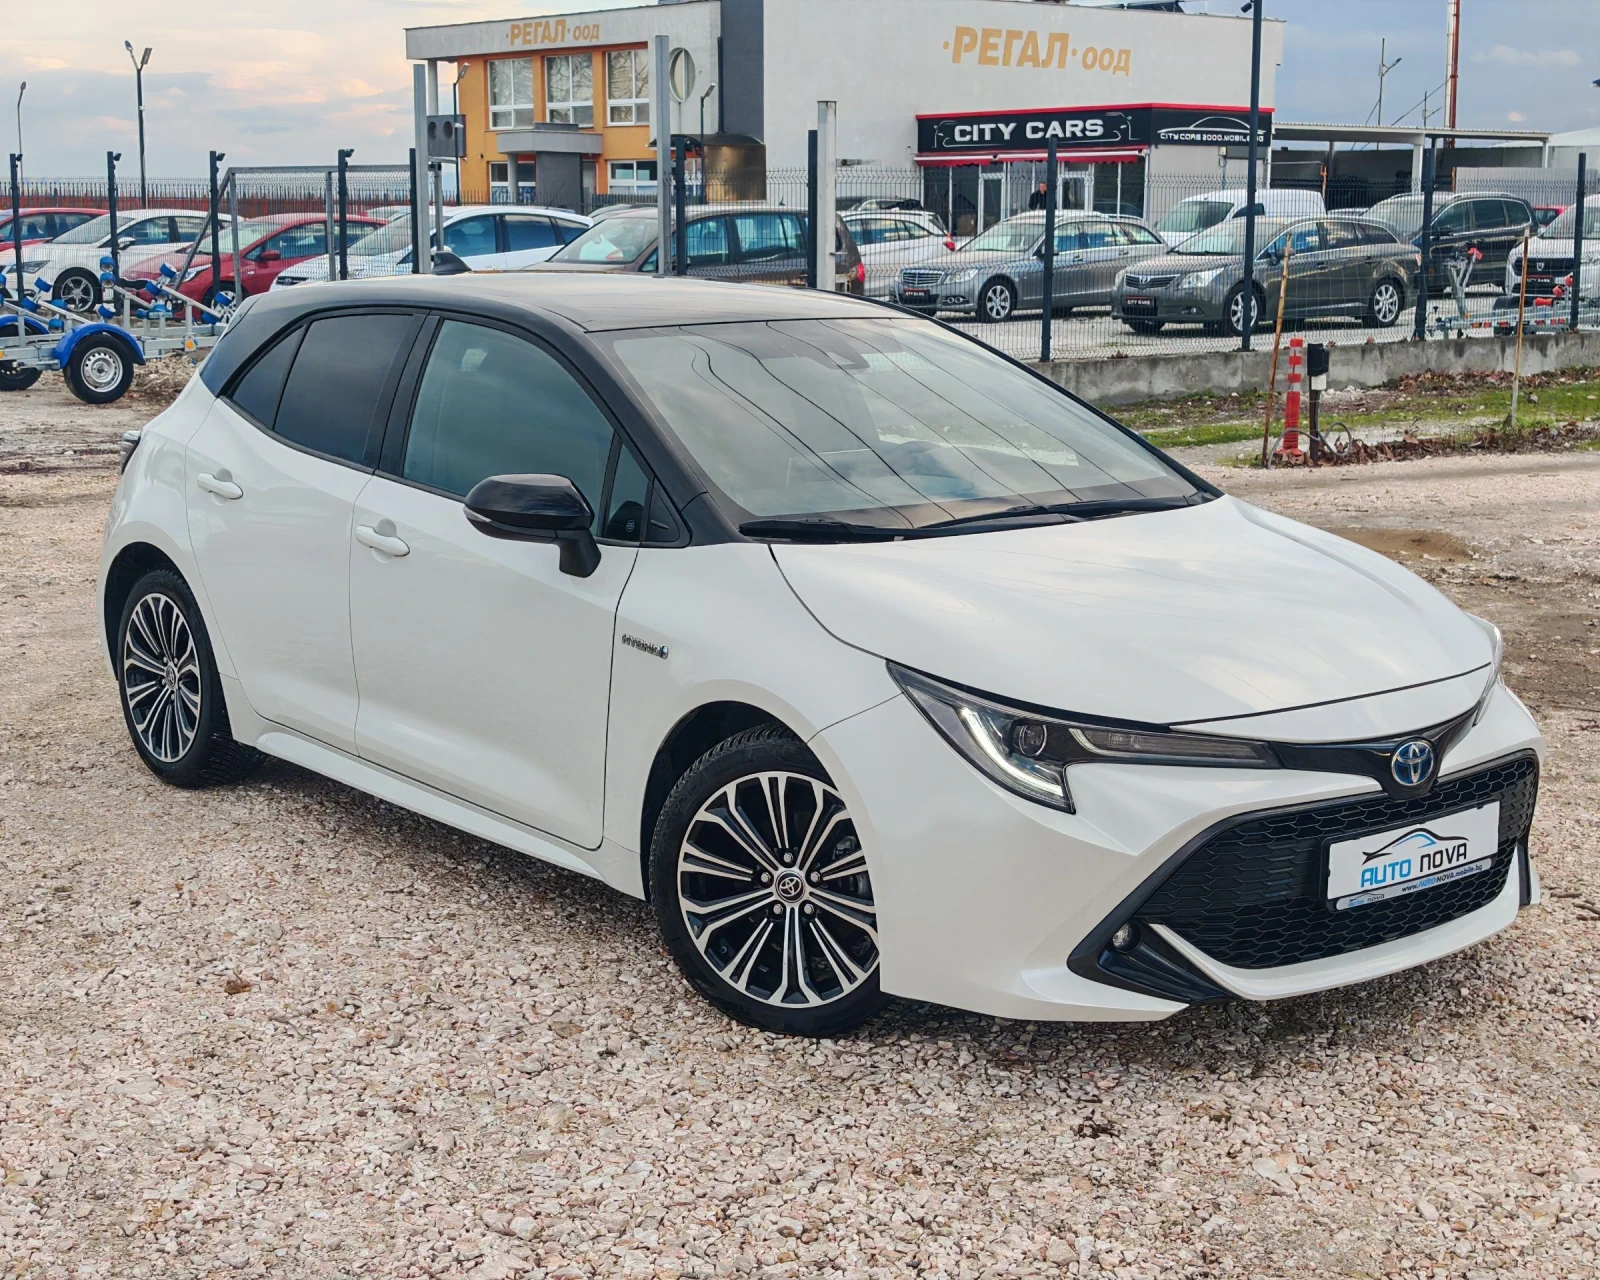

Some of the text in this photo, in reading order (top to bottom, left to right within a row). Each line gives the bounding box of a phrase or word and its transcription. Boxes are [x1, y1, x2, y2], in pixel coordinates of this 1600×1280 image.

[510, 19, 566, 46] РЕГАЛ
[952, 26, 1070, 69] РЕГАЛ
[954, 119, 1104, 142] CITY CARS
[1160, 132, 1179, 140] CITY
[1180, 133, 1201, 141] CARS
[1360, 842, 1467, 888] AUTO NOVA
